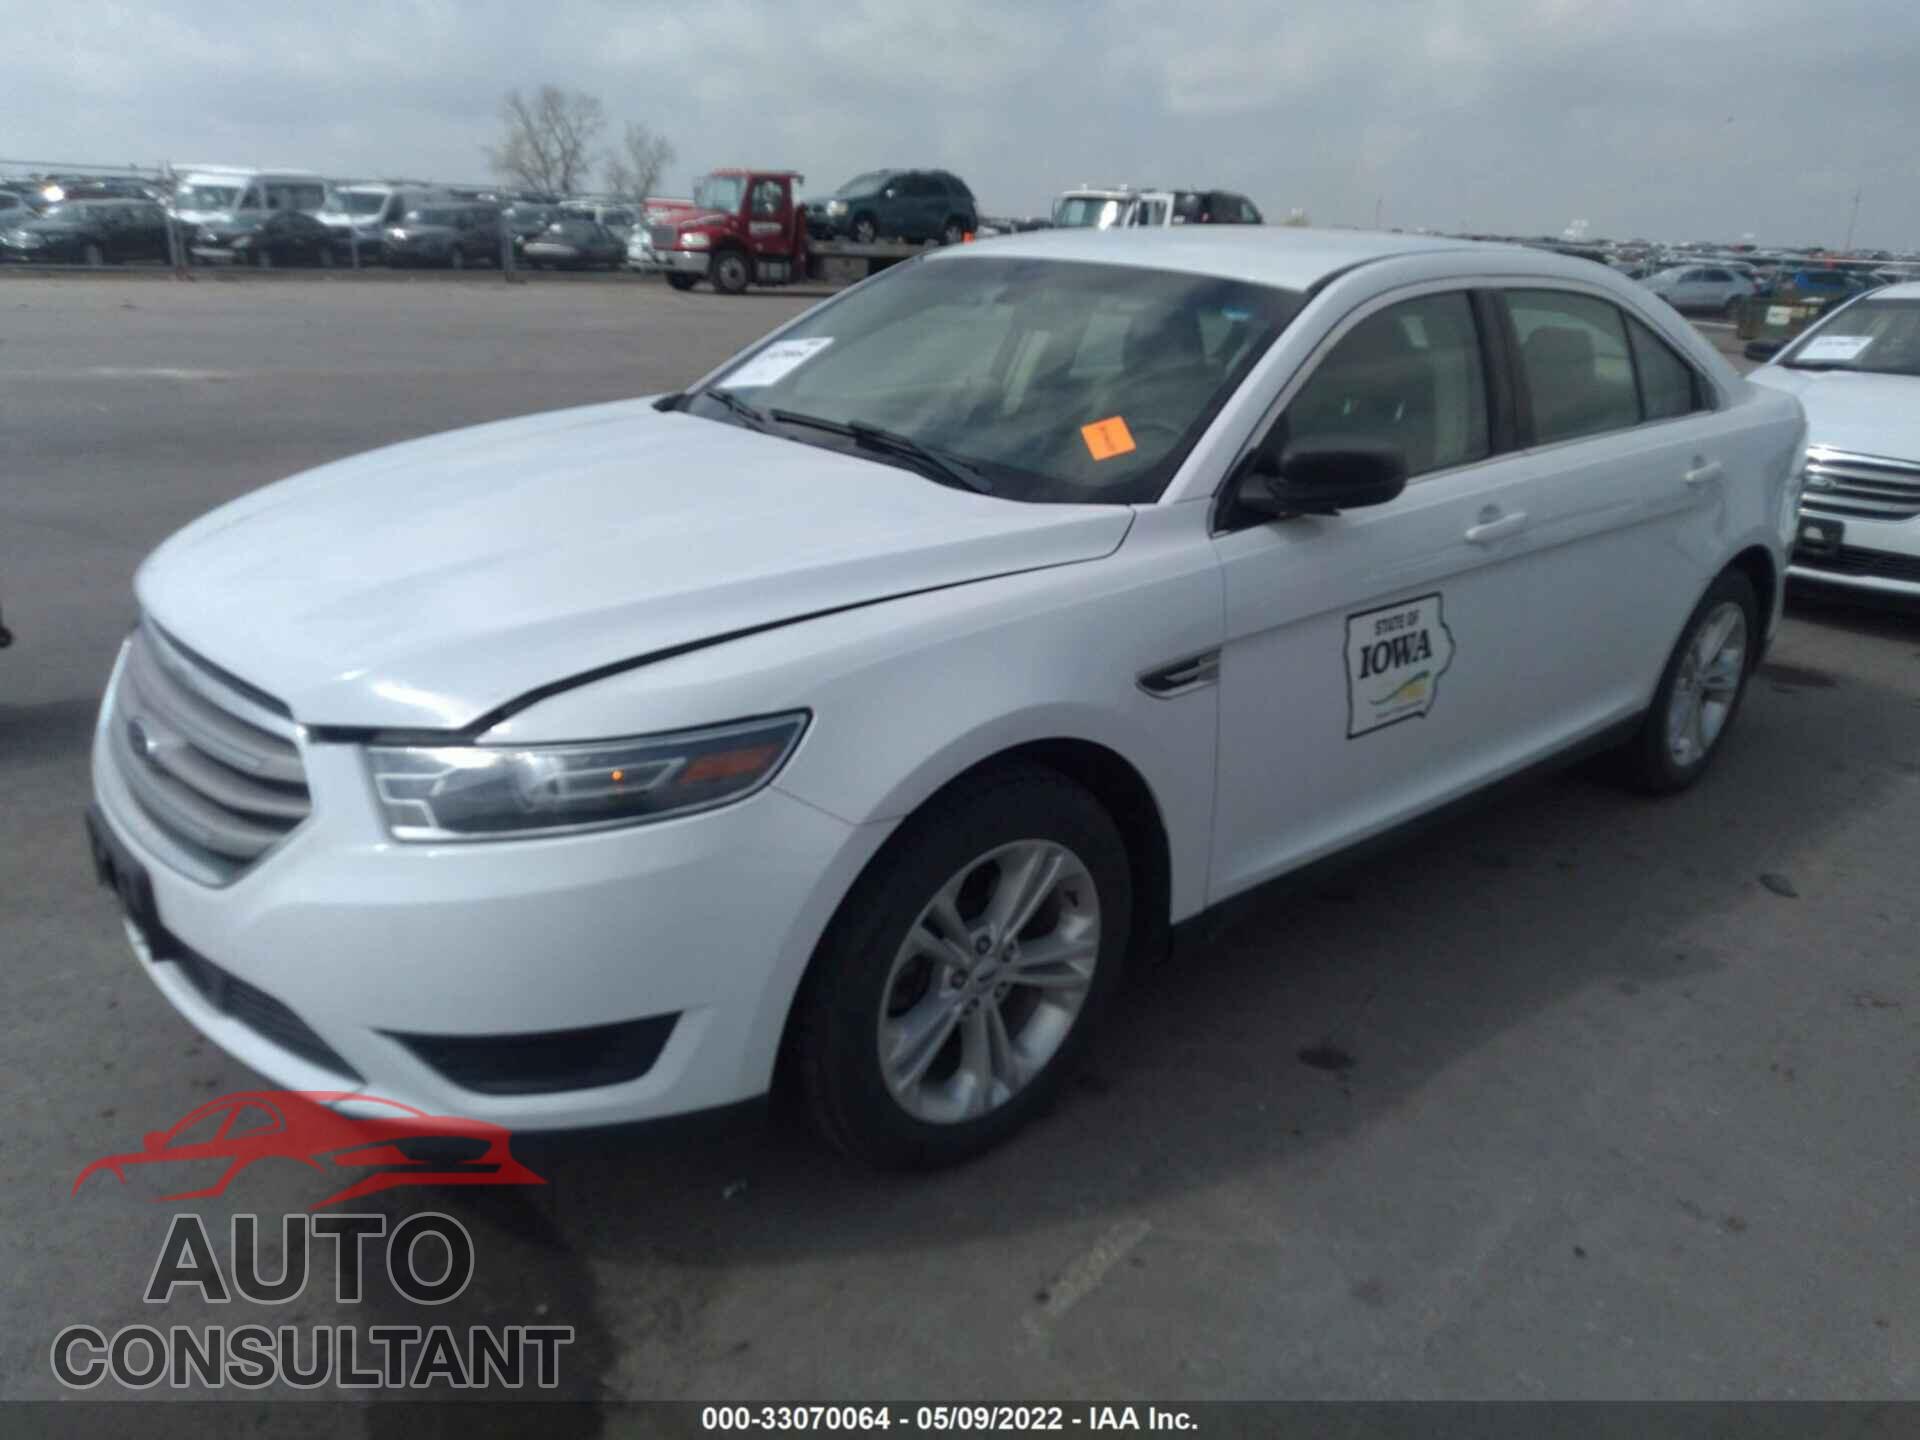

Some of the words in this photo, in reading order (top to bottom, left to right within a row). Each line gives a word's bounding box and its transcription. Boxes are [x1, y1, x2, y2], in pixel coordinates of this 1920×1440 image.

[1375, 613, 1405, 637] STATE
[1406, 609, 1420, 627] OF
[1359, 628, 1433, 679] IOWA
